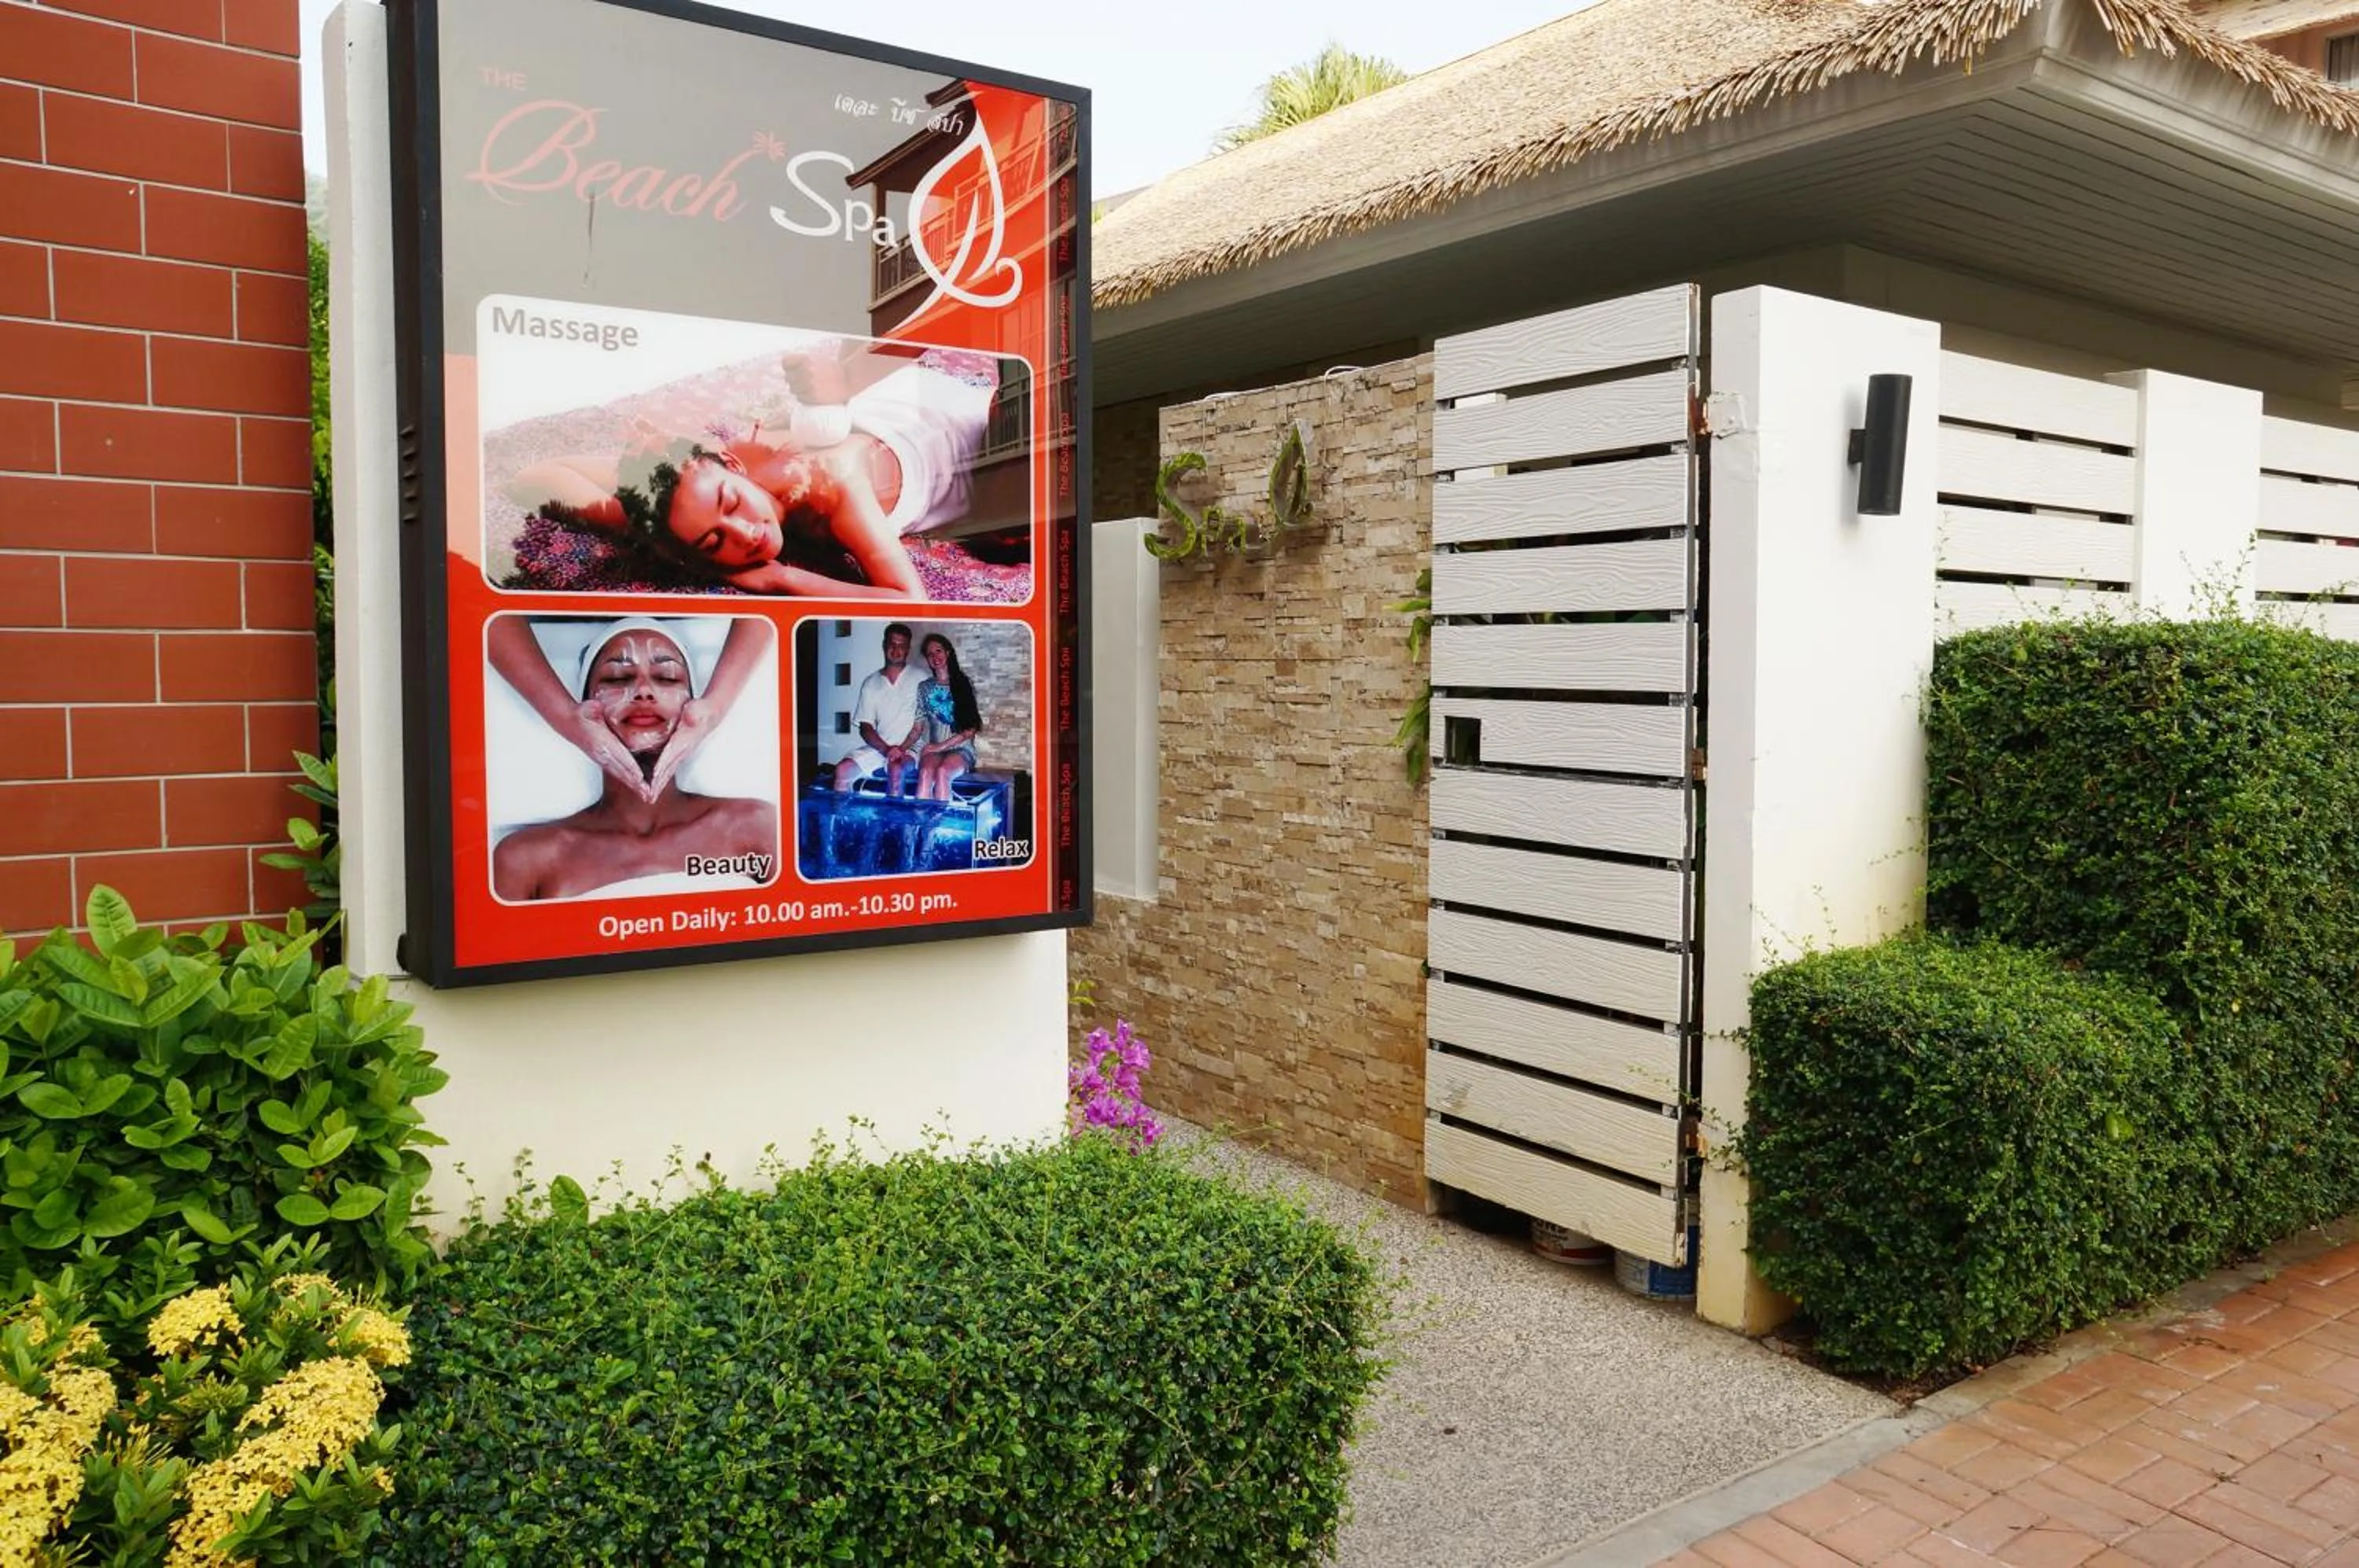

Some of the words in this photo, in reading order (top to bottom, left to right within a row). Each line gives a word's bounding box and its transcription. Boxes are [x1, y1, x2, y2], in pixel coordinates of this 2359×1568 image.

[479, 66, 527, 91] THE
[463, 99, 786, 222] Beach
[770, 150, 900, 252] Spa
[492, 306, 639, 352] Massage
[1059, 476, 1069, 497] The
[1059, 530, 1069, 550] Spa
[1059, 555, 1069, 589] Beach
[1059, 593, 1069, 615] The
[1059, 672, 1070, 706] Beach
[1059, 710, 1070, 731] The
[1060, 763, 1071, 784] Spa
[1060, 786, 1071, 822] Beach
[1060, 825, 1071, 847] The
[973, 837, 1029, 859] Relax
[686, 852, 772, 878] Beauty
[1062, 880, 1072, 901] Spa
[598, 915, 665, 940] Open
[671, 906, 738, 932] Daily:
[743, 902, 804, 926] 10.00
[920, 893, 958, 914] pm.
